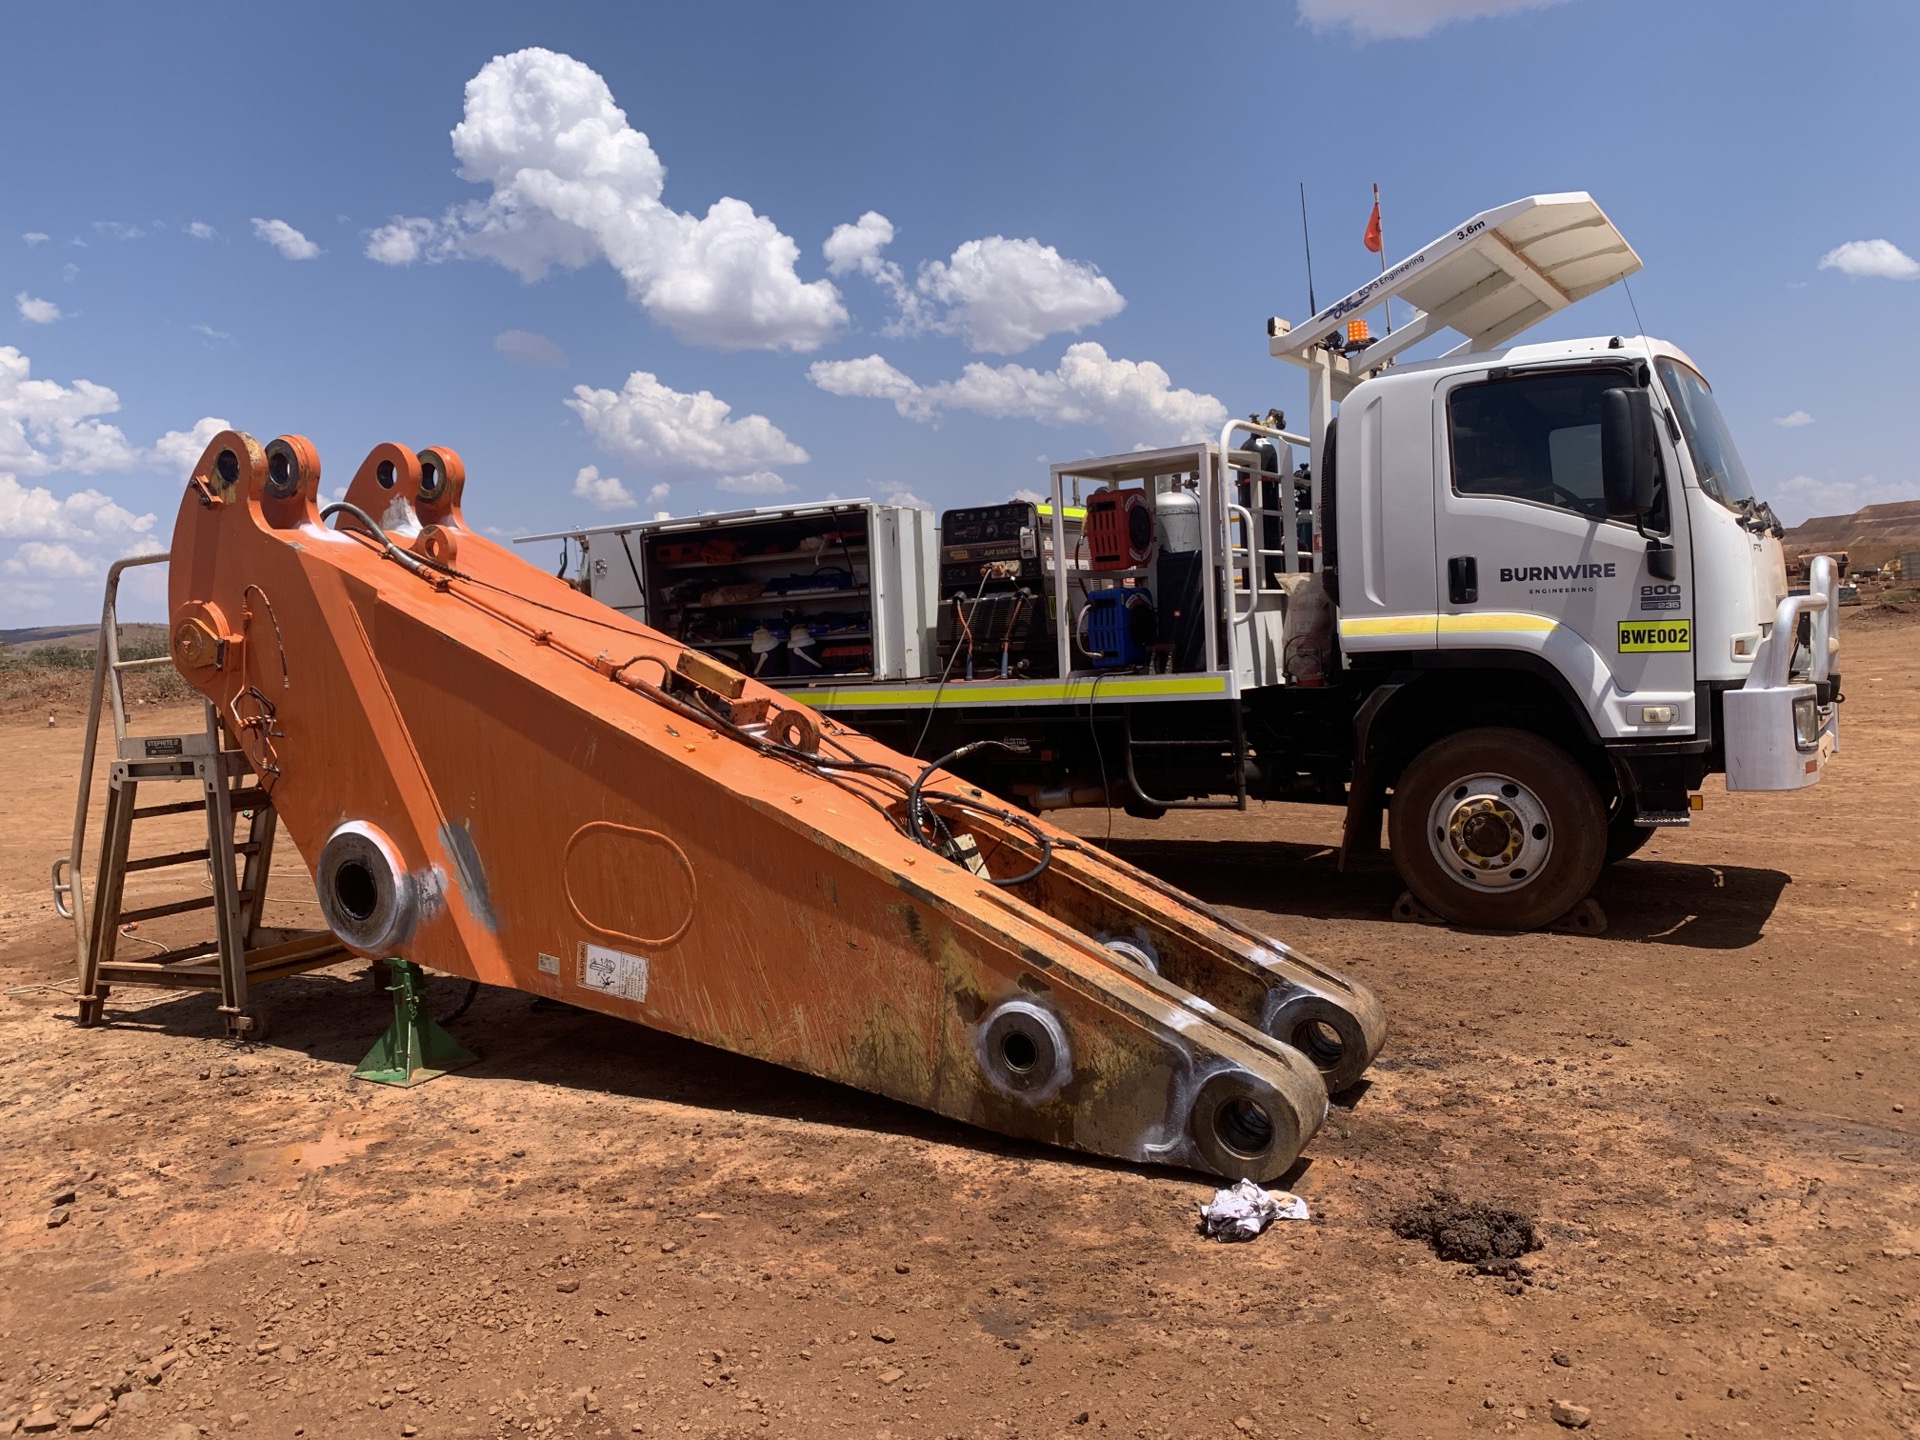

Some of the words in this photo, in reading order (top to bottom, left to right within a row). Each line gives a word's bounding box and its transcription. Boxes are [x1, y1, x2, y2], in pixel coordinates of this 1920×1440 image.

[1457, 220, 1485, 240] 3.6m
[1358, 281, 1379, 298] ROPS
[1379, 255, 1425, 285] Engineering
[1500, 563, 1616, 582] BURNWIRE
[1529, 586, 1594, 595] ENGINEERING
[1641, 584, 1681, 596] 800
[1620, 628, 1688, 645] BWE002
